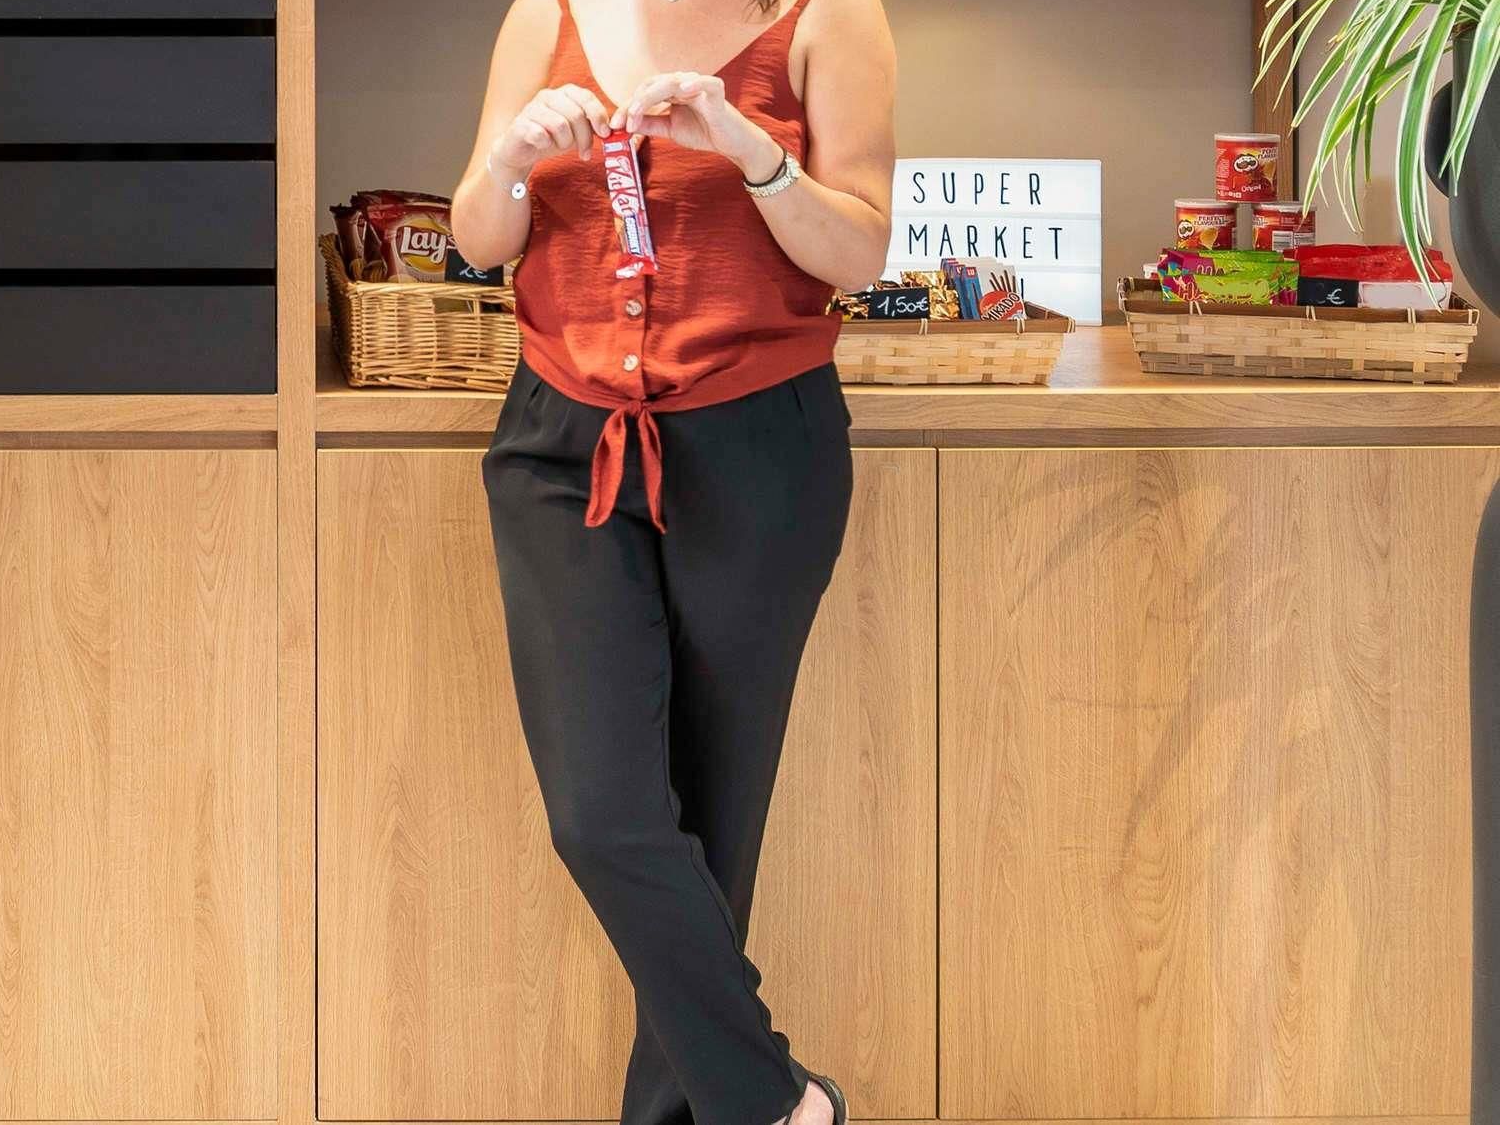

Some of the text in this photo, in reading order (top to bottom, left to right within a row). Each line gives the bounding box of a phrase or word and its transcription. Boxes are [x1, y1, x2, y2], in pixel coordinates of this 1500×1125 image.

[912, 171, 1042, 206] SUPER
[907, 223, 1063, 260] MARKET
[981, 291, 1021, 321] MIKADO
